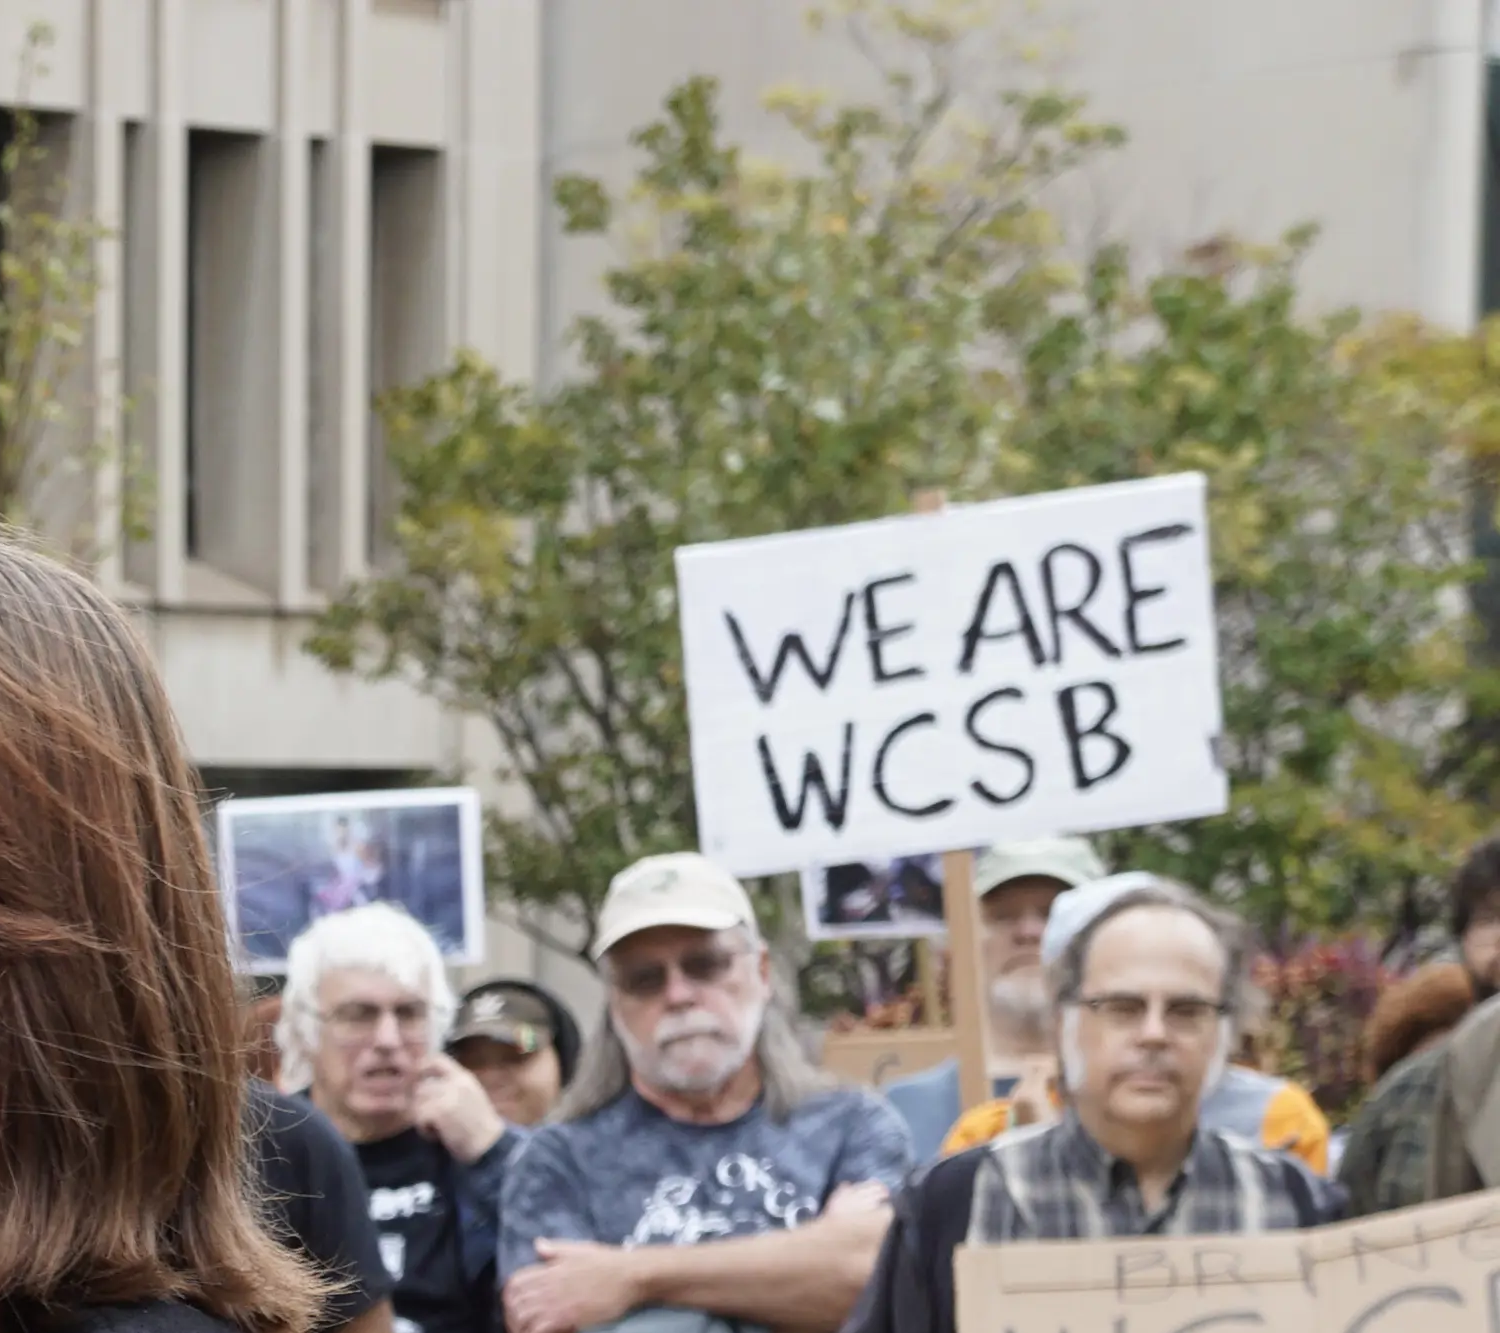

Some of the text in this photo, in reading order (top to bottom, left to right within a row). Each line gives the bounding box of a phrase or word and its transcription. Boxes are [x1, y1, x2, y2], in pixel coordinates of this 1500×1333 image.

[723, 523, 1193, 704] WE ARE
[757, 681, 1132, 832] WCSB
